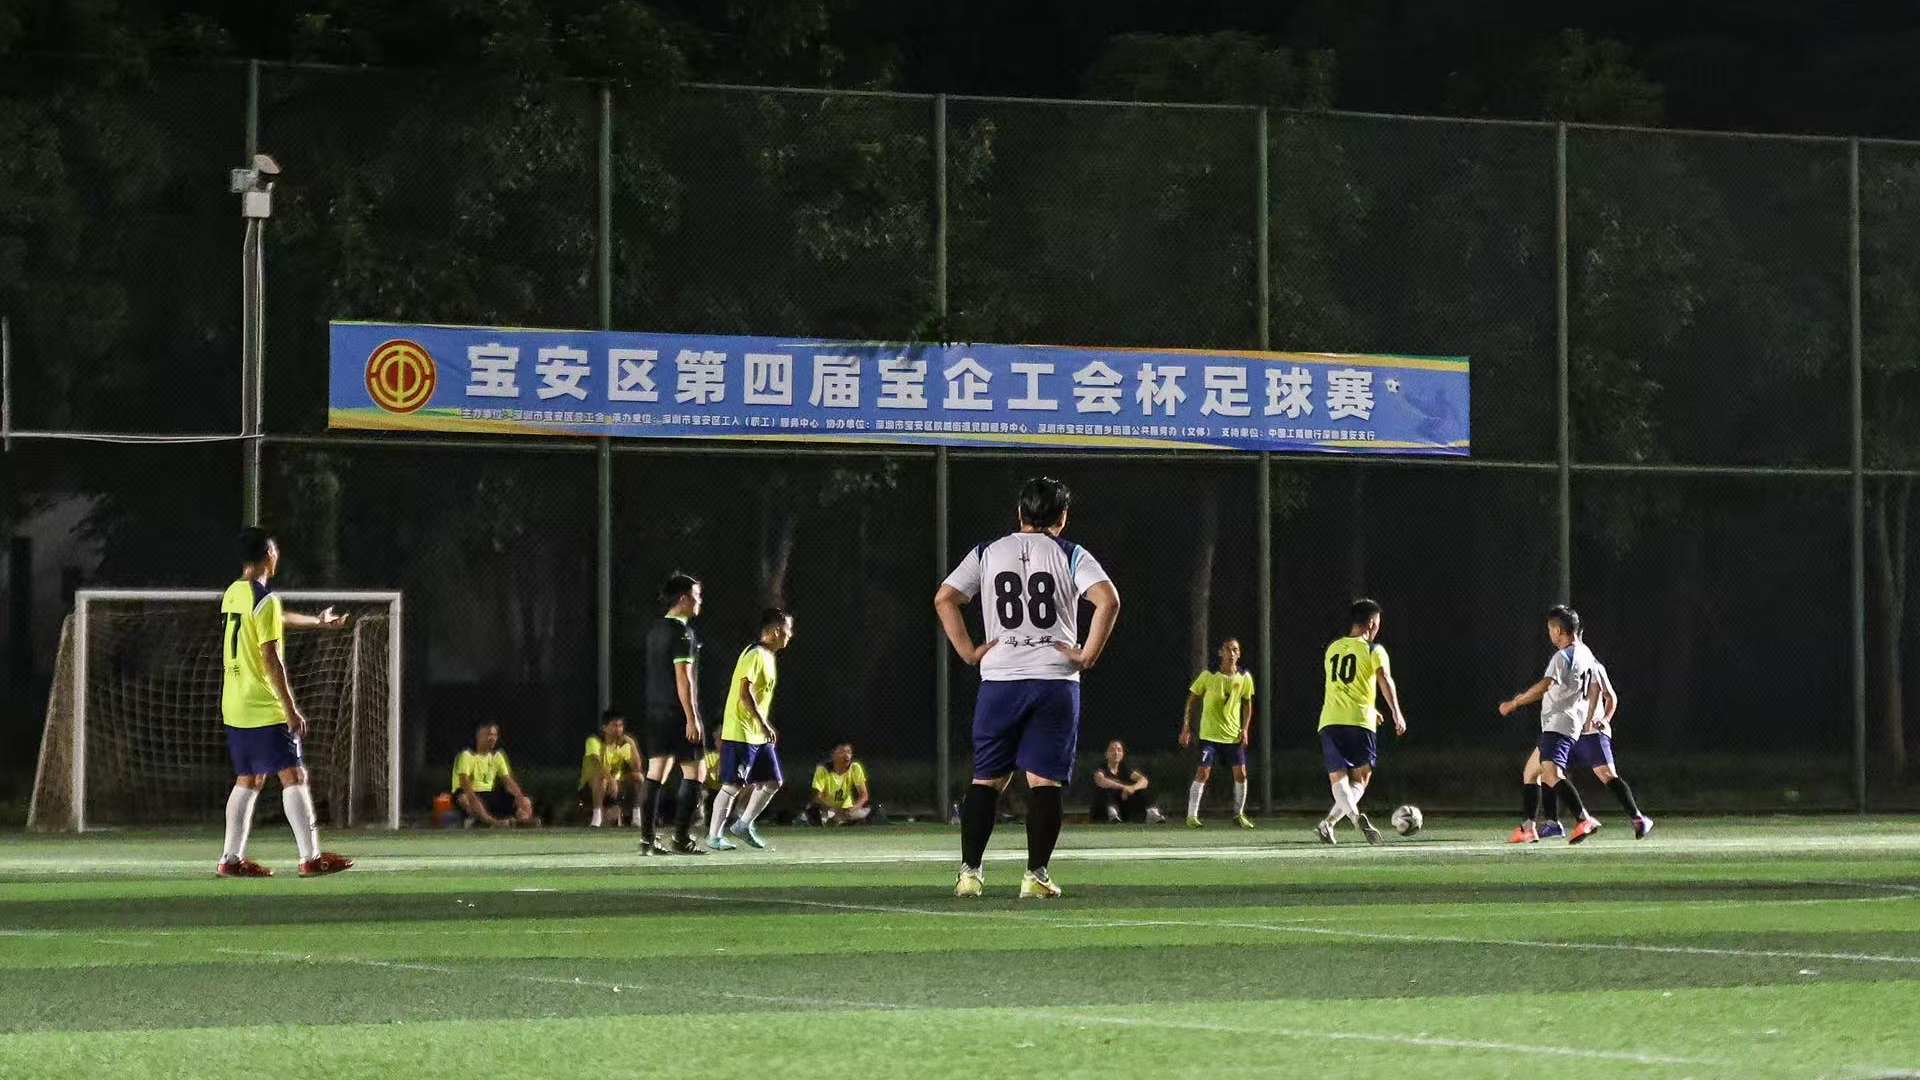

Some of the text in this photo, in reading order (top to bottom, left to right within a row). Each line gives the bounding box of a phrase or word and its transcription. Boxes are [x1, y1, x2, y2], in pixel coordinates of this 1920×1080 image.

[466, 343, 1376, 421] 宝安区第四届宝企工会杯足球赛
[994, 571, 1058, 630] 88
[1329, 653, 1357, 685] 10
[1202, 750, 1208, 762] 7
